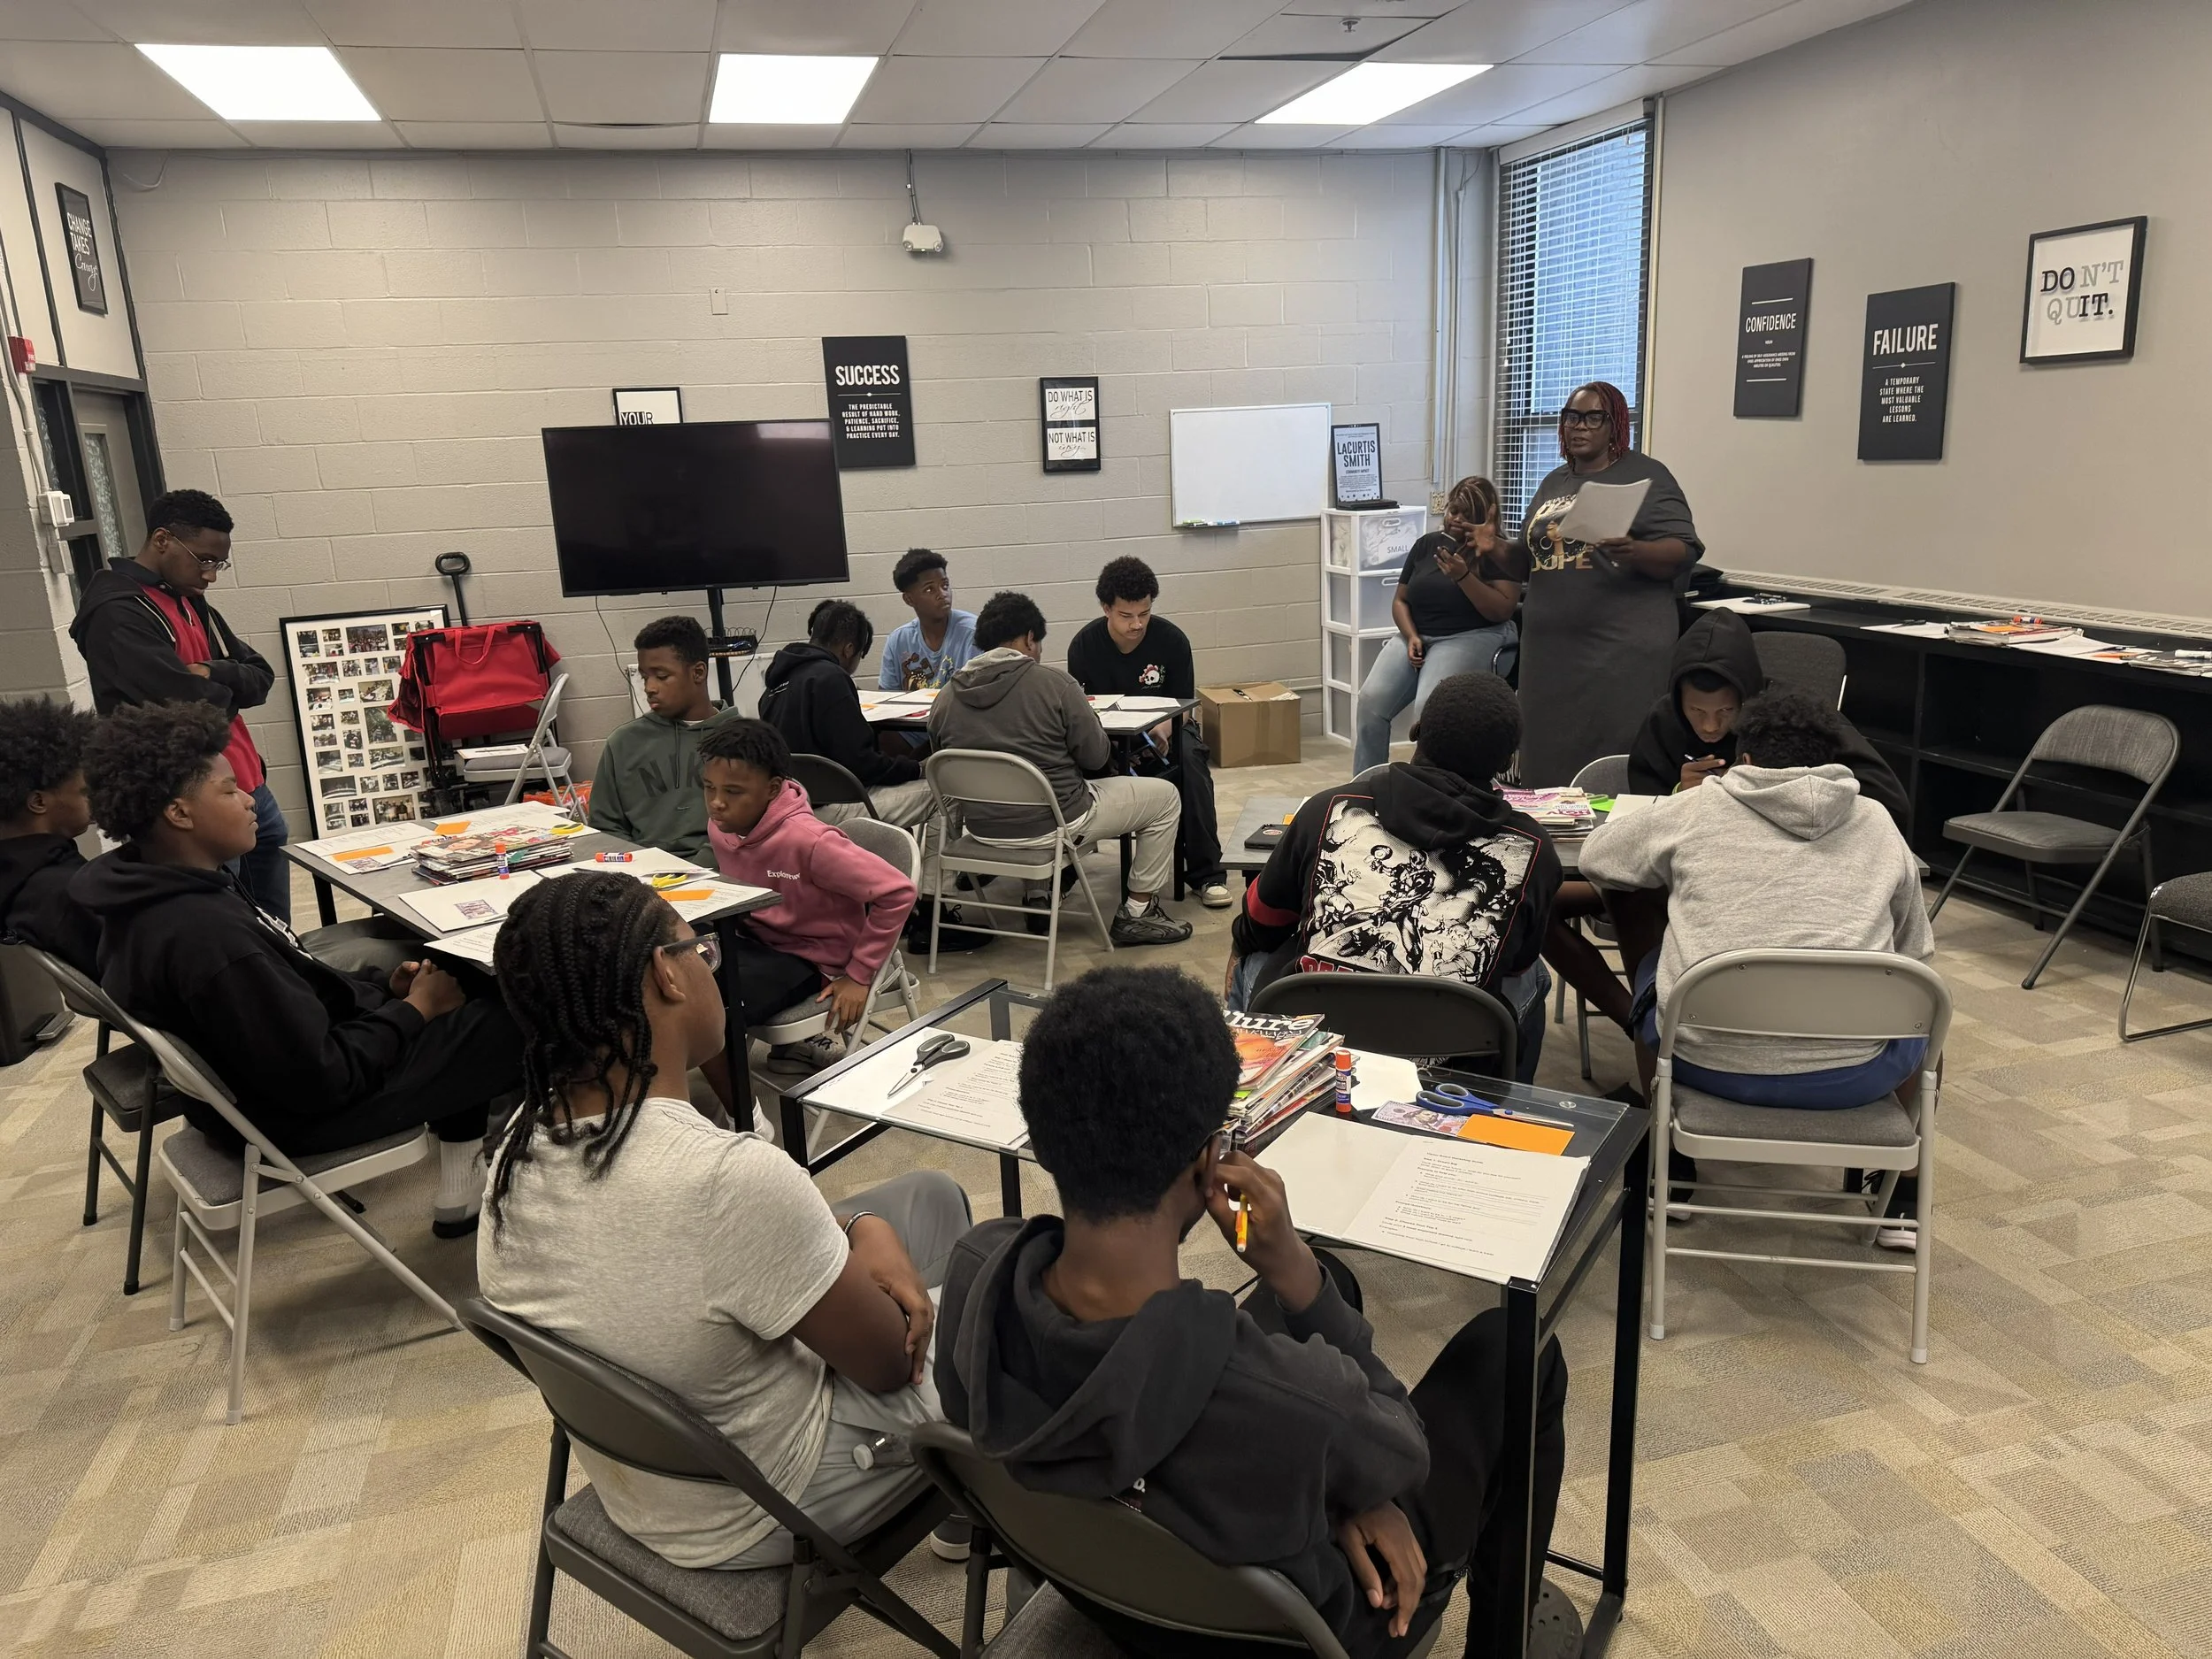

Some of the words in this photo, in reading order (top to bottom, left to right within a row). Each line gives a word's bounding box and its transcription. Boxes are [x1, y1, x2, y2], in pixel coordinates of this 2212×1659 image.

[67, 212, 92, 237] CHANGE
[70, 232, 89, 255] TAKES
[2047, 293, 2113, 325] QUIT.
[1746, 313, 1797, 333] CONFIDENCE
[1873, 323, 1939, 356] FAILURE
[835, 365, 900, 386] SUCCESS
[1890, 376, 1919, 386] TEMPORARY
[1048, 391, 1058, 403] DO
[1061, 391, 1083, 402] WHAT
[1086, 390, 1093, 401] IS
[1896, 395, 1921, 403] VALUABLE
[619, 411, 653, 425] YOUR
[1050, 400, 1090, 419] right
[1893, 413, 1916, 422] LEARNED.
[1048, 433, 1064, 443] NOT
[1065, 432, 1086, 442] WHAT
[1088, 432, 1094, 442] IS
[1344, 454, 1371, 467] SMITH
[1387, 545, 1409, 554] SMALL
[638, 752, 705, 798] NIK
[1223, 1009, 1315, 1031] lure
